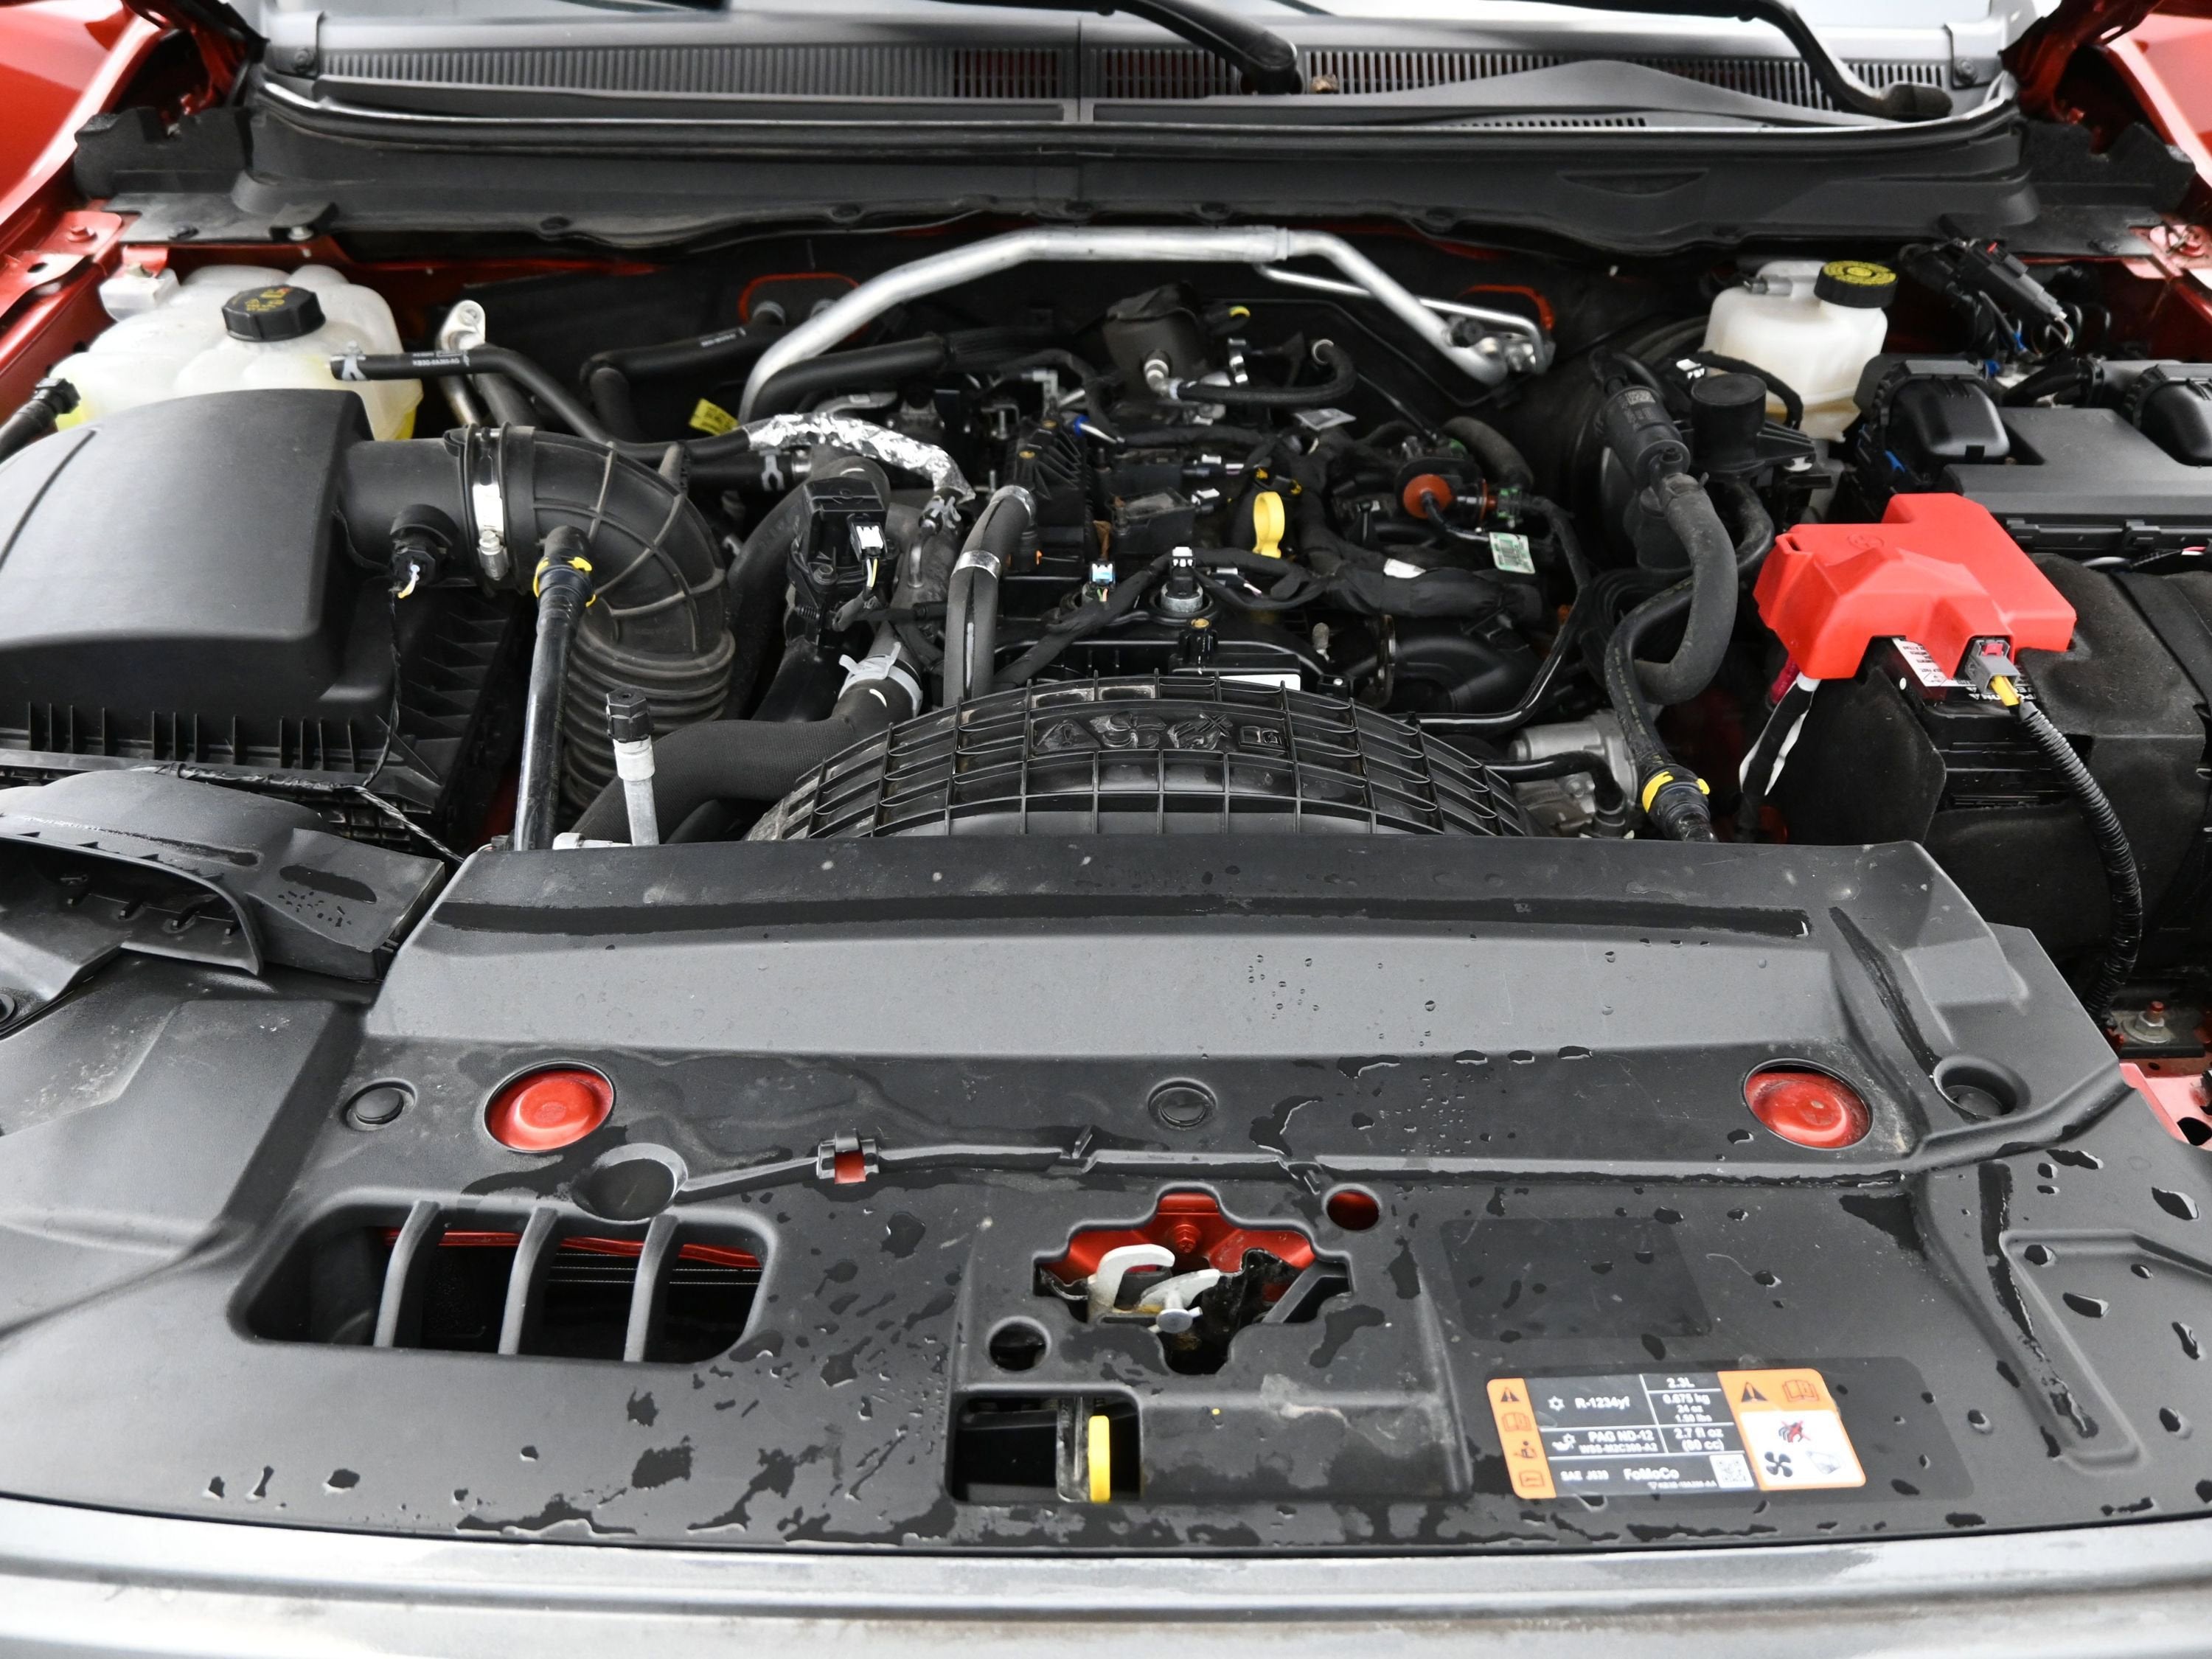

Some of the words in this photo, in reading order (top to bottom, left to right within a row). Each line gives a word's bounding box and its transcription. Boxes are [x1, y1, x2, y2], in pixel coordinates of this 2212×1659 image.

[1666, 1377, 1694, 1388] 2.3L
[1575, 1397, 1630, 1409] R-1234yf
[1694, 1393, 1711, 1405] kg
[1587, 1430, 1616, 1442] PAG
[1616, 1430, 1655, 1441] ND-12
[1674, 1427, 1692, 1439] 2.7
[1707, 1428, 1724, 1438] oz
[1704, 1439, 1724, 1451] cc)
[1624, 1467, 1679, 1480] FoMoCo
